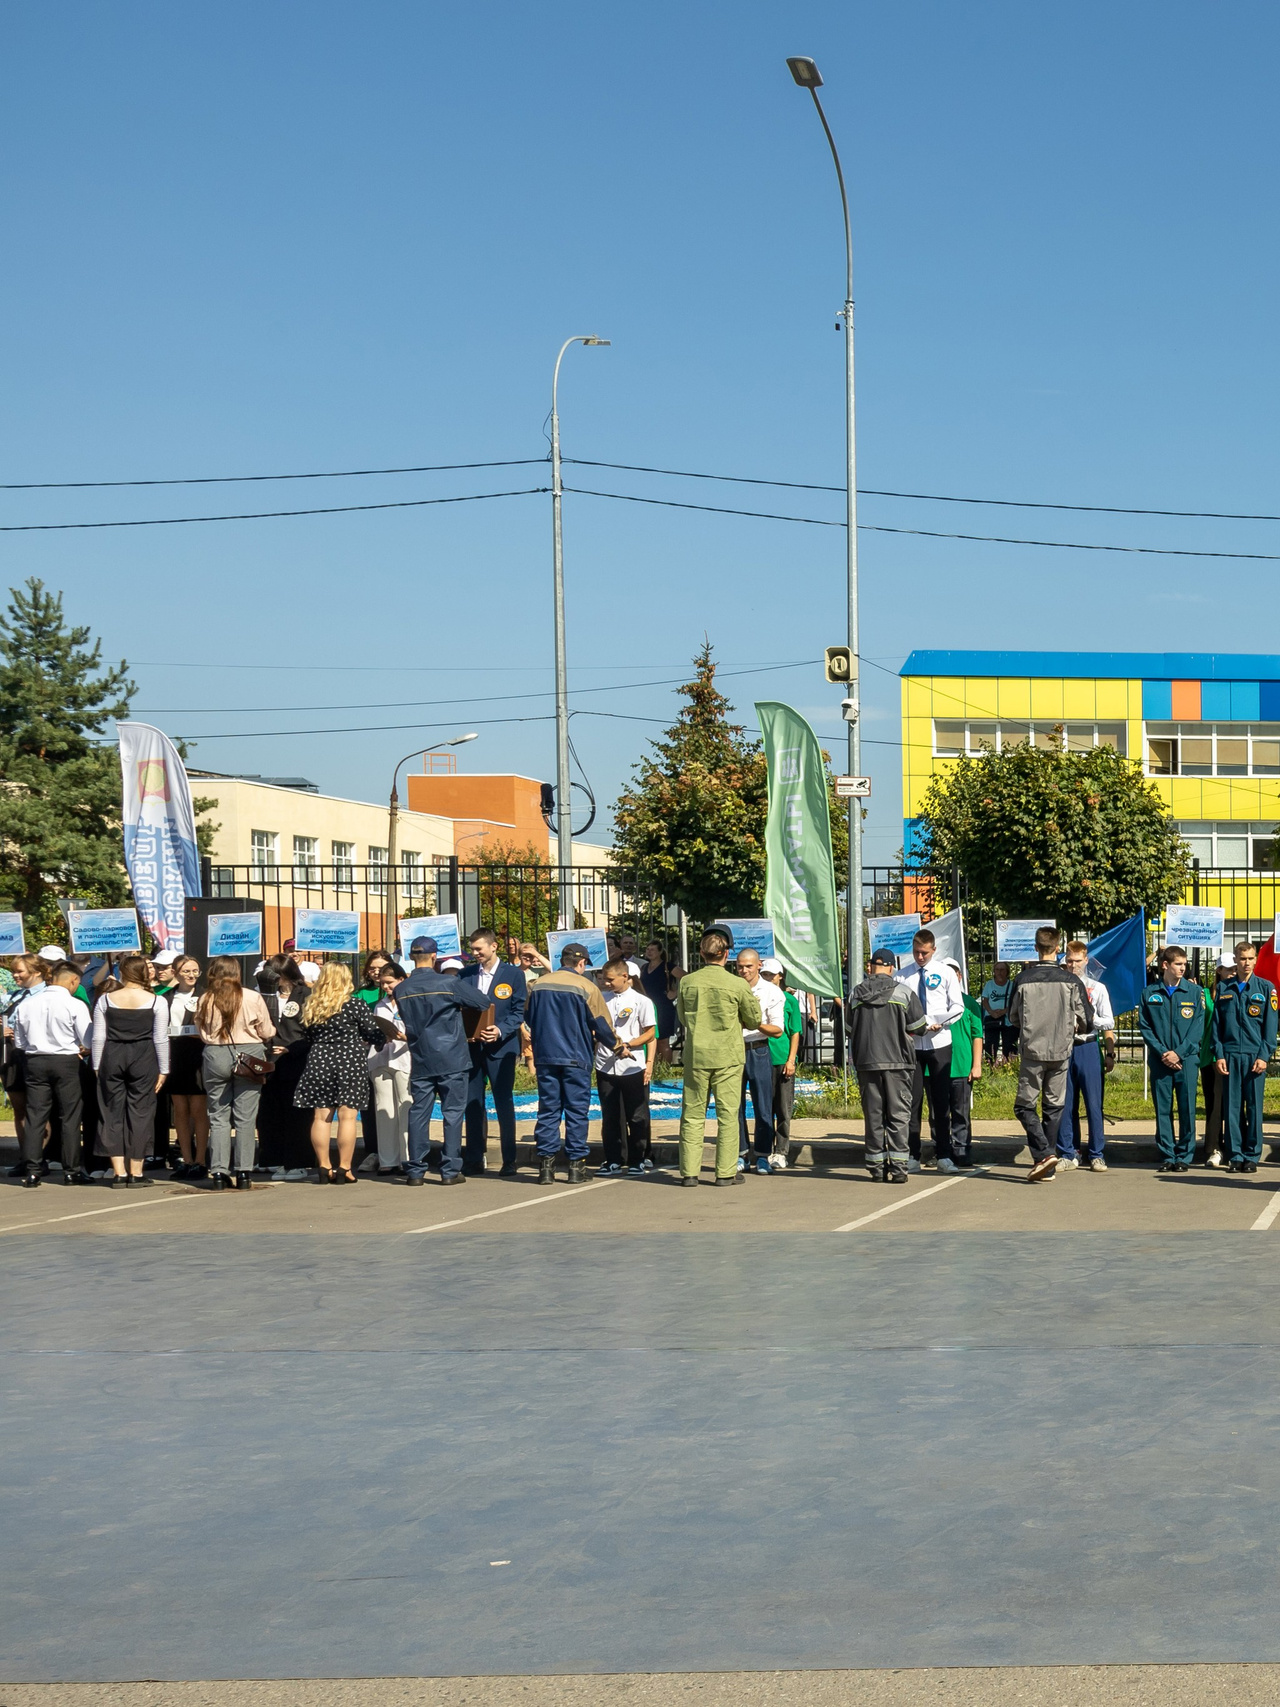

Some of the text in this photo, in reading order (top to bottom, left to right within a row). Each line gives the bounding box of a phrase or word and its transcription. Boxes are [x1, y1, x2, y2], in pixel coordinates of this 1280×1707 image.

[73, 925, 136, 933] Садово-парковое
[300, 928, 356, 936] Изобразительное
[1171, 926, 1218, 934] чрезвычайных
[84, 932, 133, 940] ландшафтное
[220, 932, 249, 941] Дизайн
[80, 939, 133, 947] строительство
[225, 938, 254, 946] отраслям)
